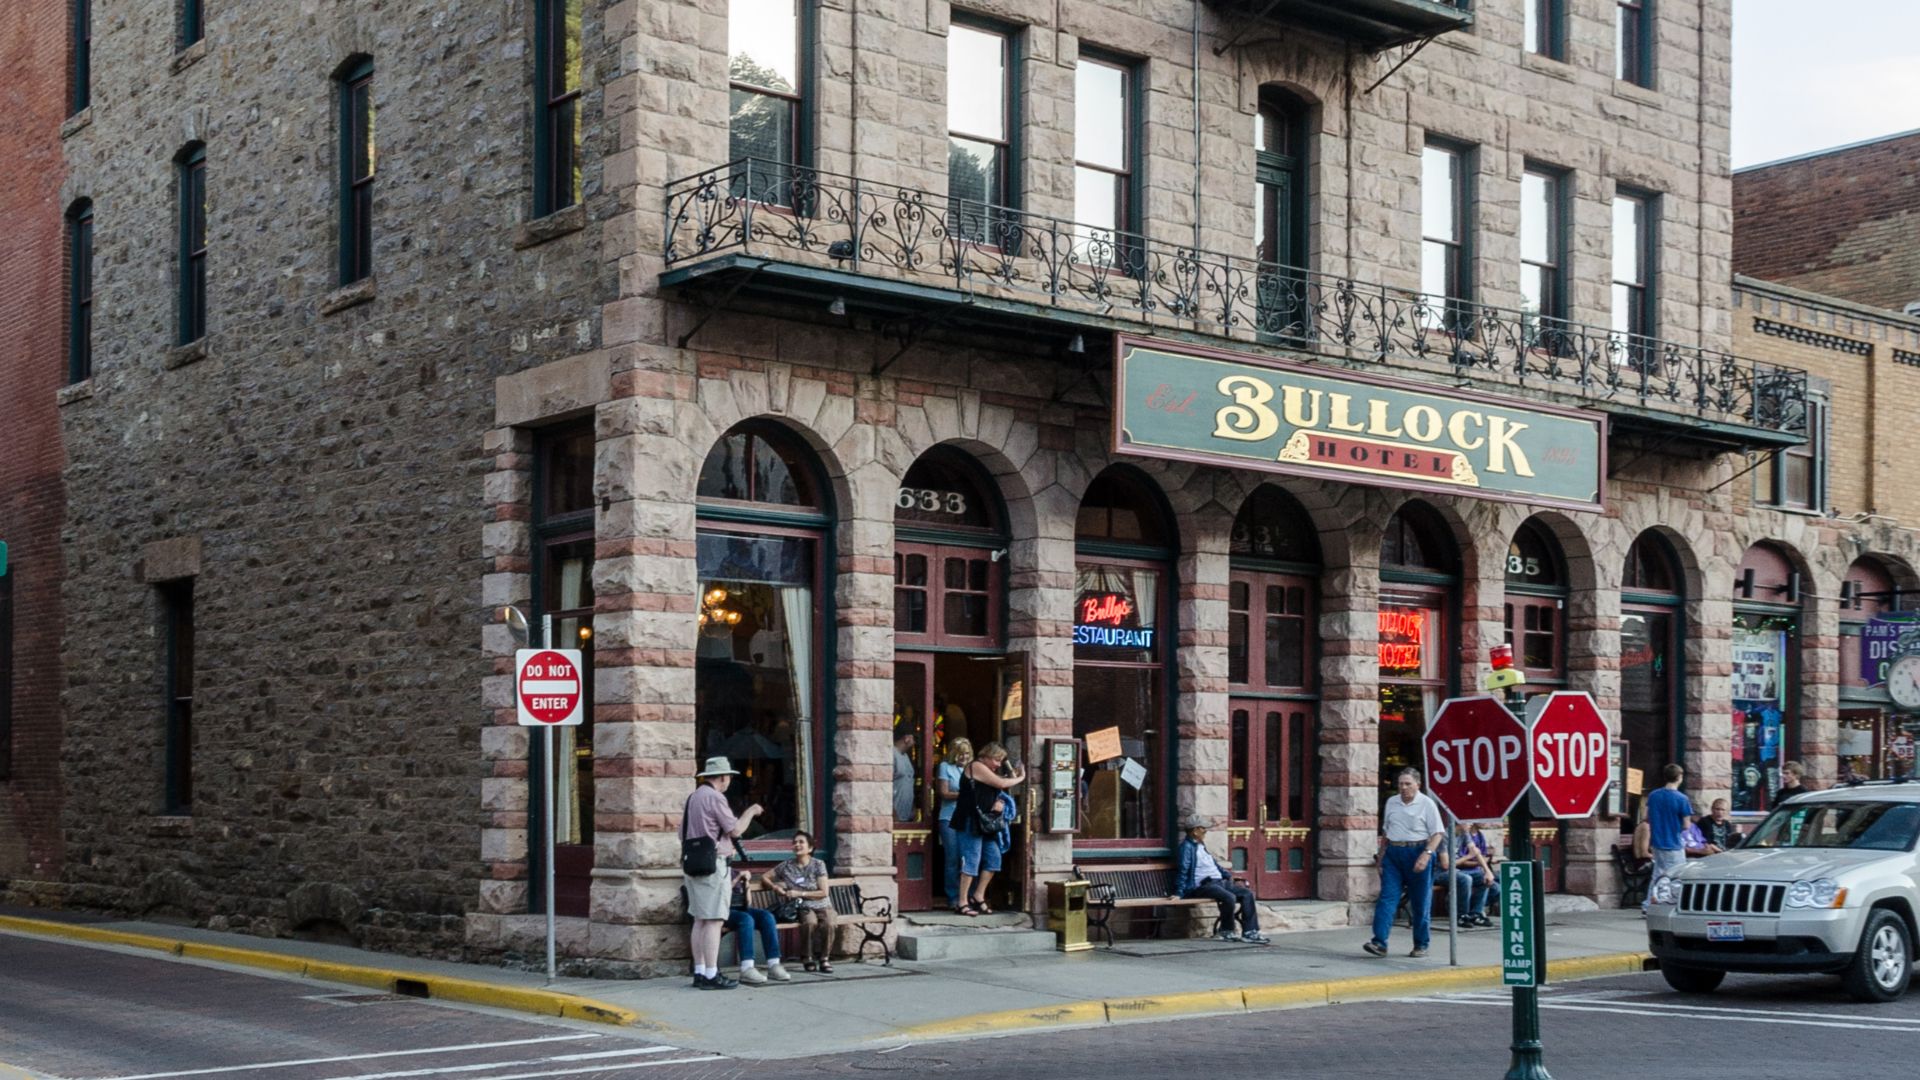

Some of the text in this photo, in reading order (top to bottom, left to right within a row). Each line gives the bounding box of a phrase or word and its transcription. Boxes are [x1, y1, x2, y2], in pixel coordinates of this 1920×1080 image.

[1212, 375, 1535, 477] BULLOCK
[1317, 440, 1447, 473] HOTEL
[896, 487, 967, 514] 633
[526, 664, 572, 677] DO NOT
[532, 697, 569, 710] ENTER
[1431, 734, 1523, 785] STOP
[1536, 731, 1605, 779] STOP
[1508, 866, 1526, 957] PARKING
[1504, 958, 1532, 969] RAMP
